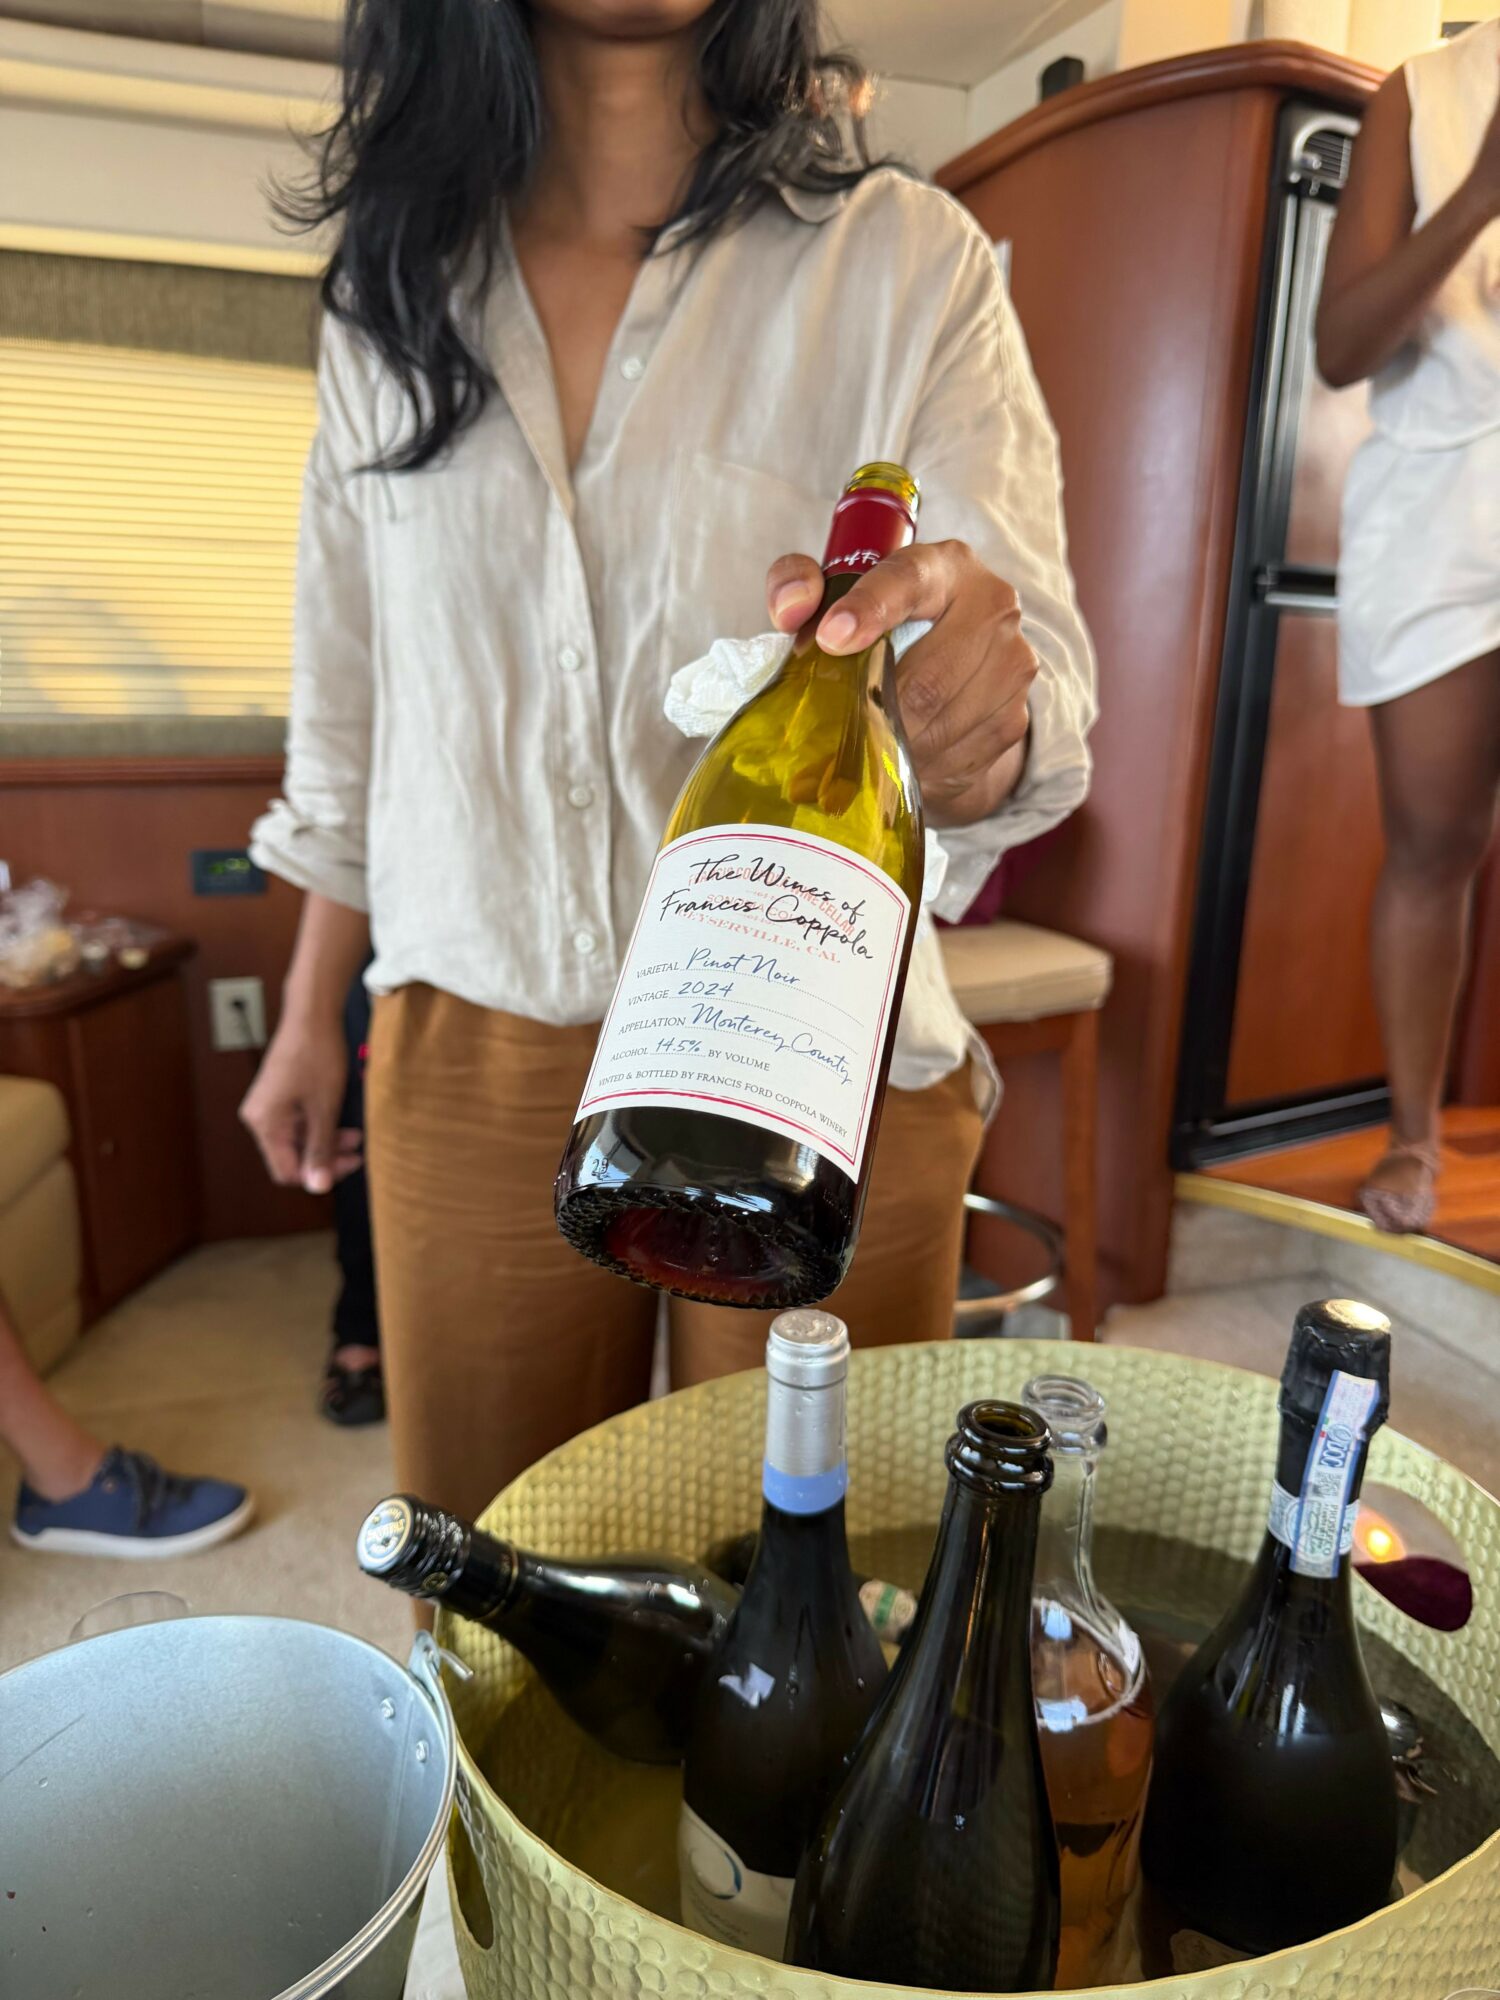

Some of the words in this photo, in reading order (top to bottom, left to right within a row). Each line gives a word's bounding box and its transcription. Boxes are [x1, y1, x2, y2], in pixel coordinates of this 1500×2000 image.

[689, 853, 741, 885] The
[751, 856, 836, 902] Wines
[842, 899, 866, 926] of
[659, 888, 759, 922] Francis
[765, 894, 874, 959] Coppola
[819, 900, 857, 937] CELLAR
[636, 961, 680, 979] VARIETAL
[686, 946, 753, 971] Pinot
[751, 954, 801, 985] Noir
[628, 989, 670, 1007] VINTAGE
[678, 981, 735, 998] 2024
[610, 1047, 649, 1062] ALCOHOL
[655, 1037, 703, 1053] 14.5%
[708, 1049, 722, 1058] BY
[724, 1051, 771, 1072] VOLUME
[618, 1016, 687, 1035] APPELLATION
[691, 1003, 791, 1053] Monterey
[791, 1032, 853, 1086] County
[626, 1071, 633, 1080] &
[635, 1069, 679, 1080] BOTTLED
[680, 1070, 695, 1080] BY
[696, 1072, 743, 1089] FRANCIS
[744, 1082, 773, 1098] FORD
[775, 1093, 817, 1119] COPPOLA
[819, 1113, 848, 1138] WINERY
